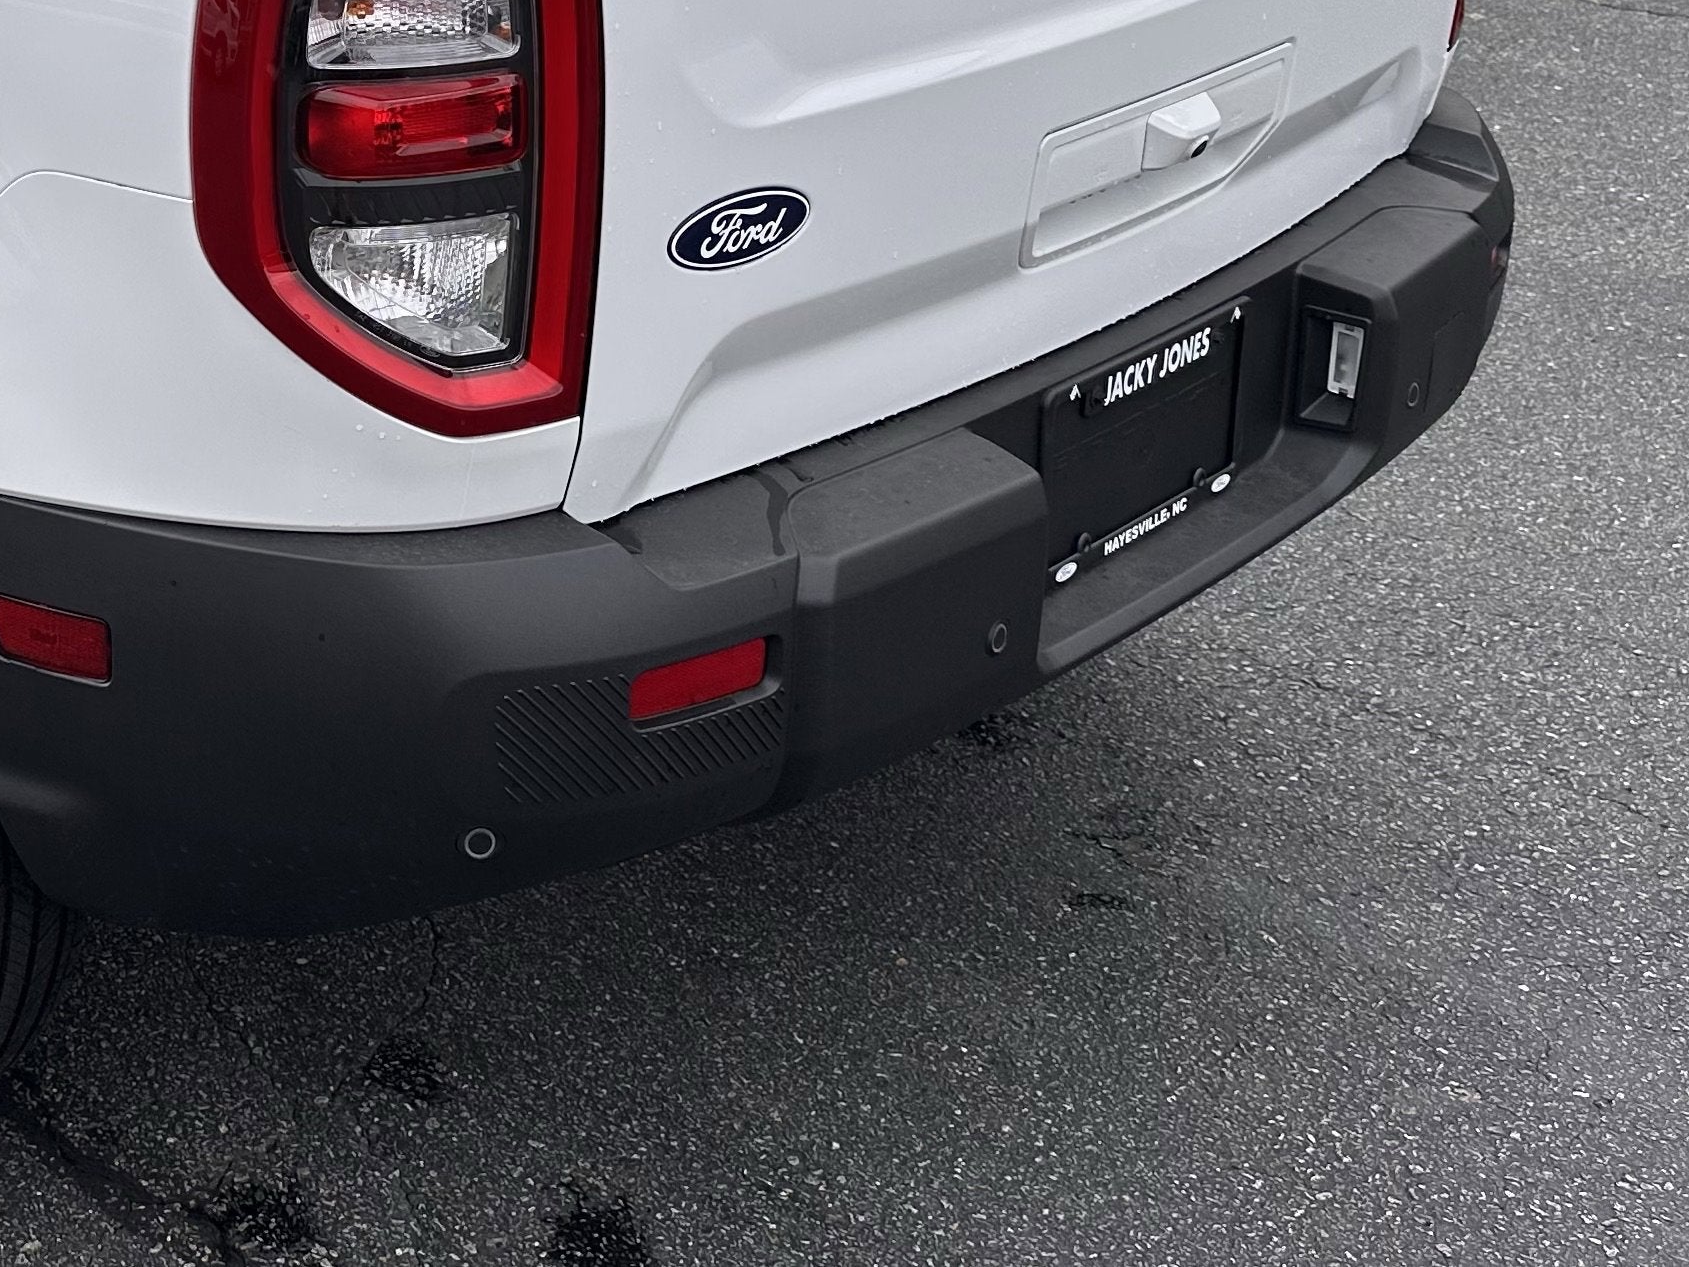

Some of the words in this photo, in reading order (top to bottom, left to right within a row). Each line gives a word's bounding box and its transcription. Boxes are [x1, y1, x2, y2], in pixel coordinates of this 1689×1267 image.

[700, 203, 787, 259] Ford
[1104, 354, 1157, 406] JACKY
[1159, 327, 1211, 379] JONES
[1104, 506, 1170, 555] HAYESVILLE,
[1172, 497, 1188, 519] NC
